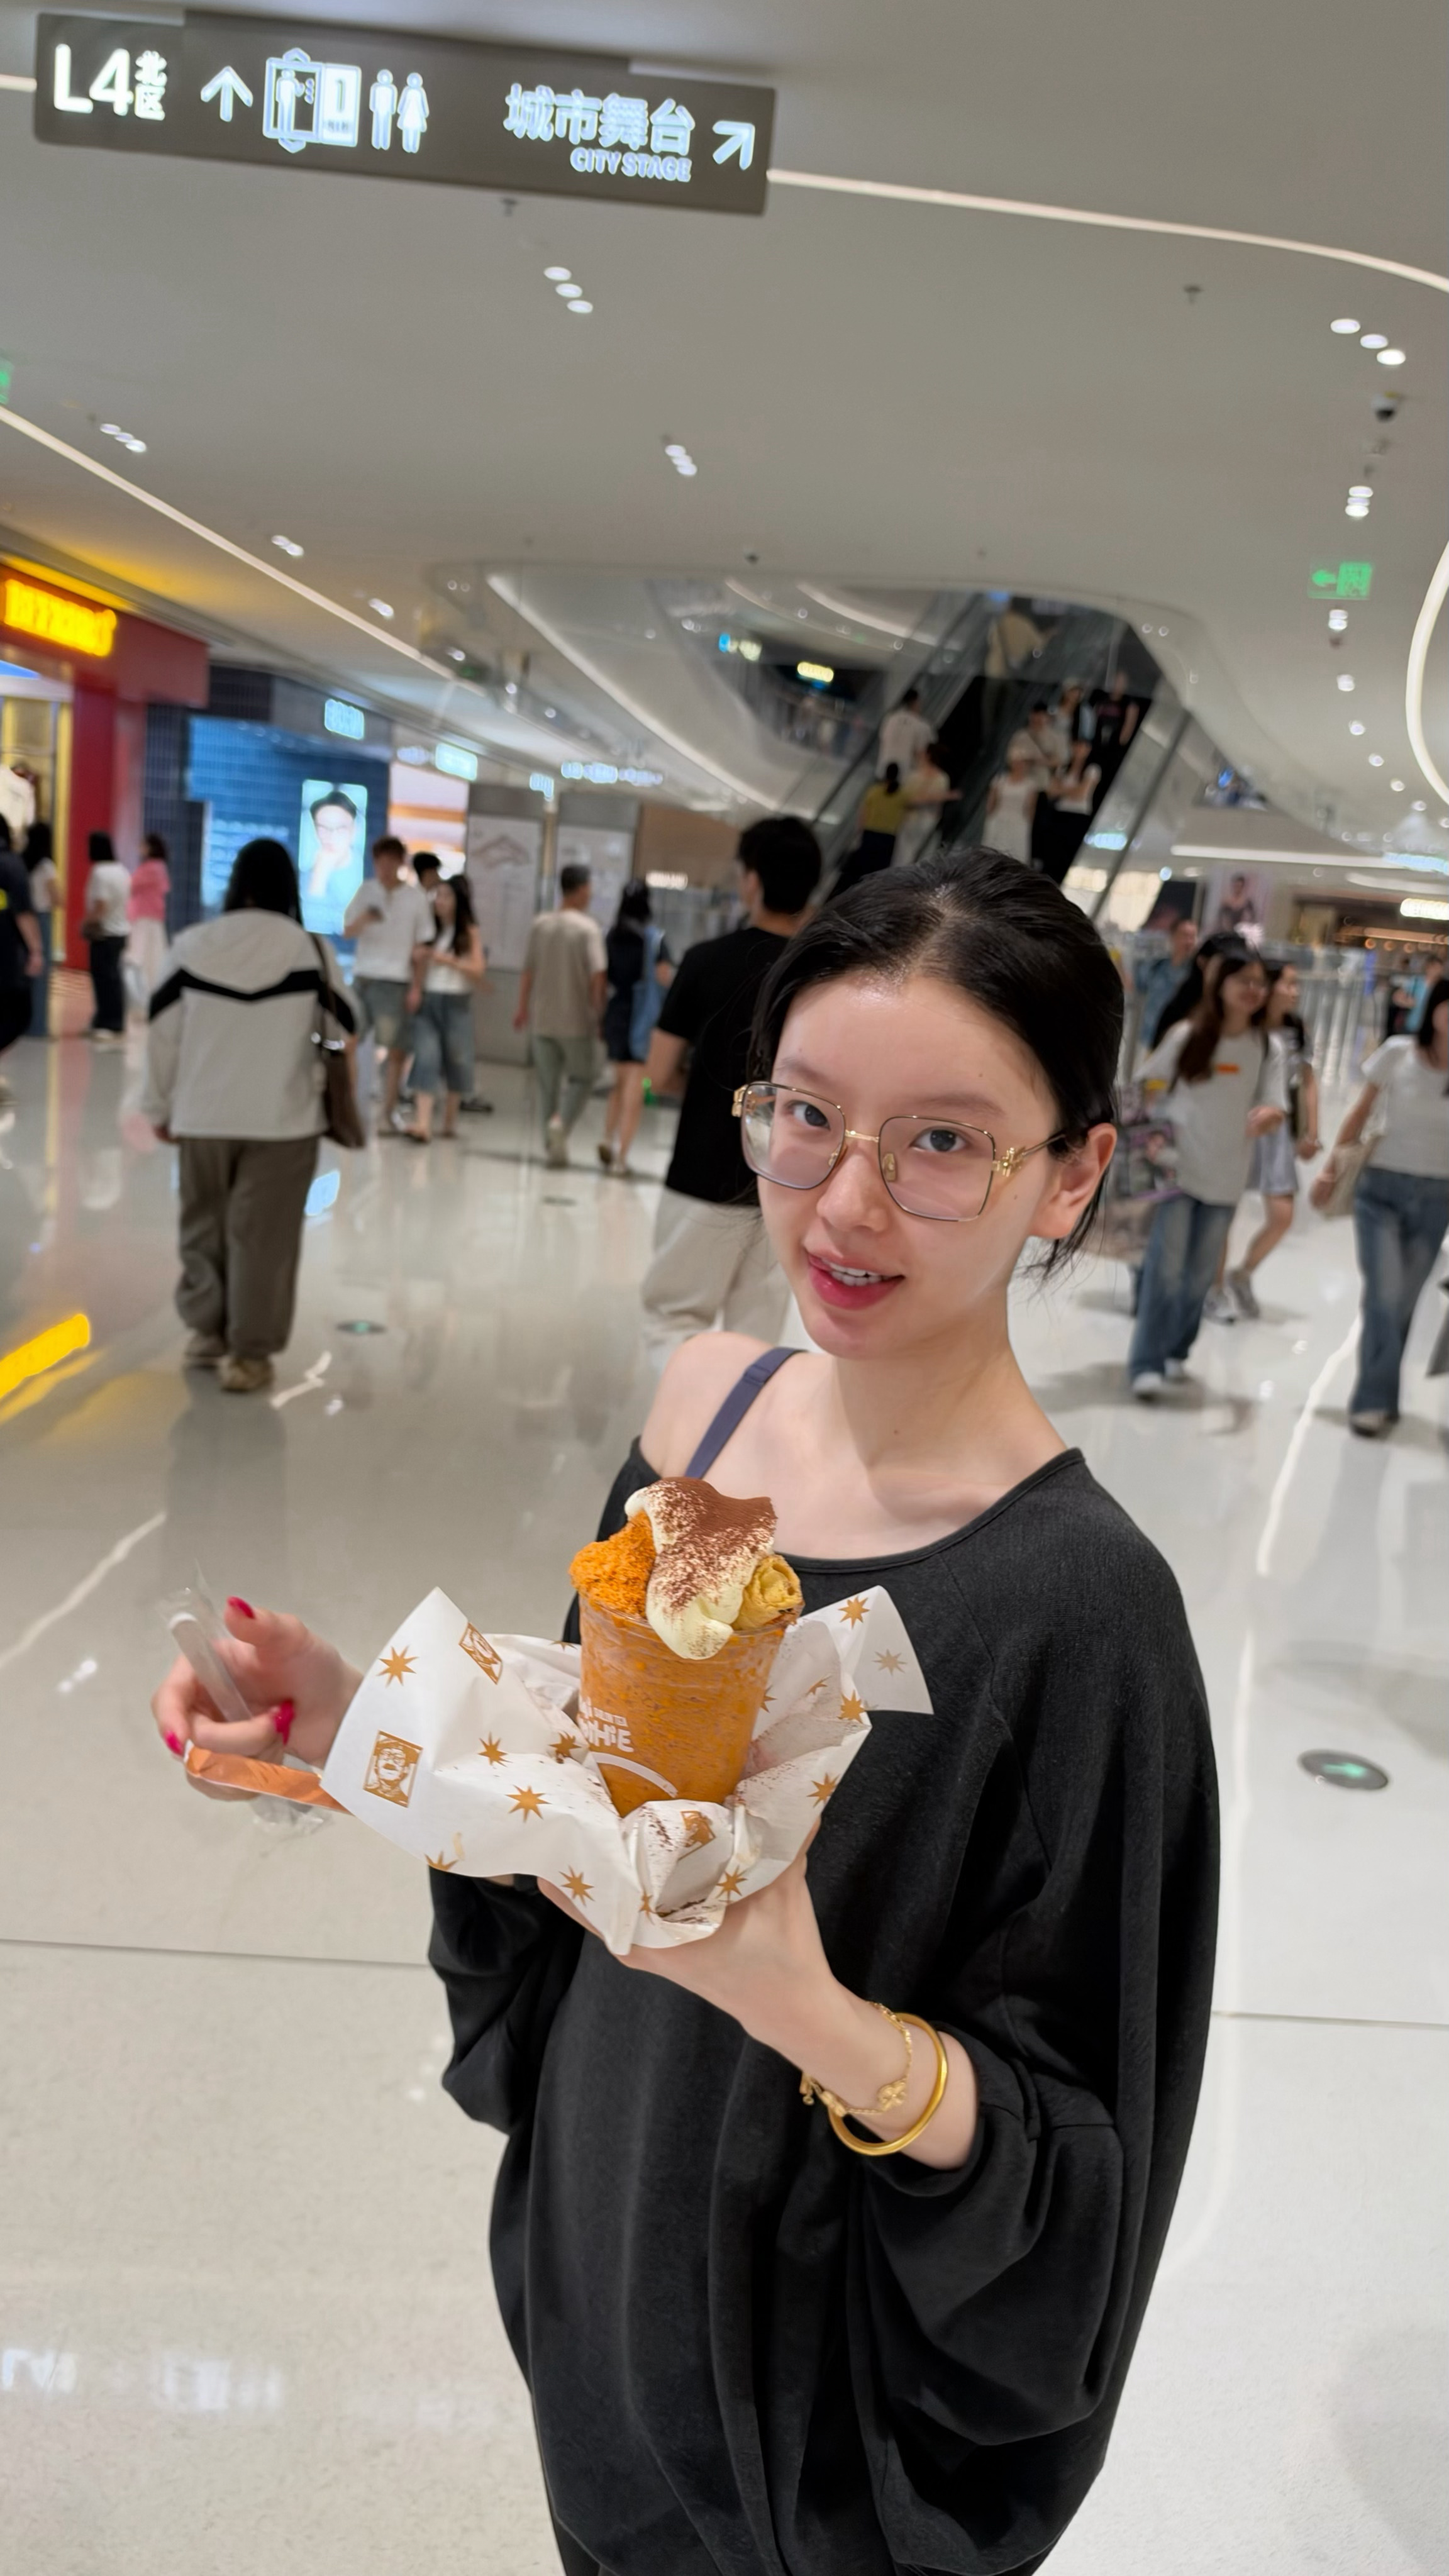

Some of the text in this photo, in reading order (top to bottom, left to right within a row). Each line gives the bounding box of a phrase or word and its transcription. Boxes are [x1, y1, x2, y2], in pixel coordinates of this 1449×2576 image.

[54, 44, 134, 116] L4
[135, 50, 167, 121] 北区
[503, 83, 696, 155] 城市舞台
[570, 147, 692, 182] CITY STAGE
